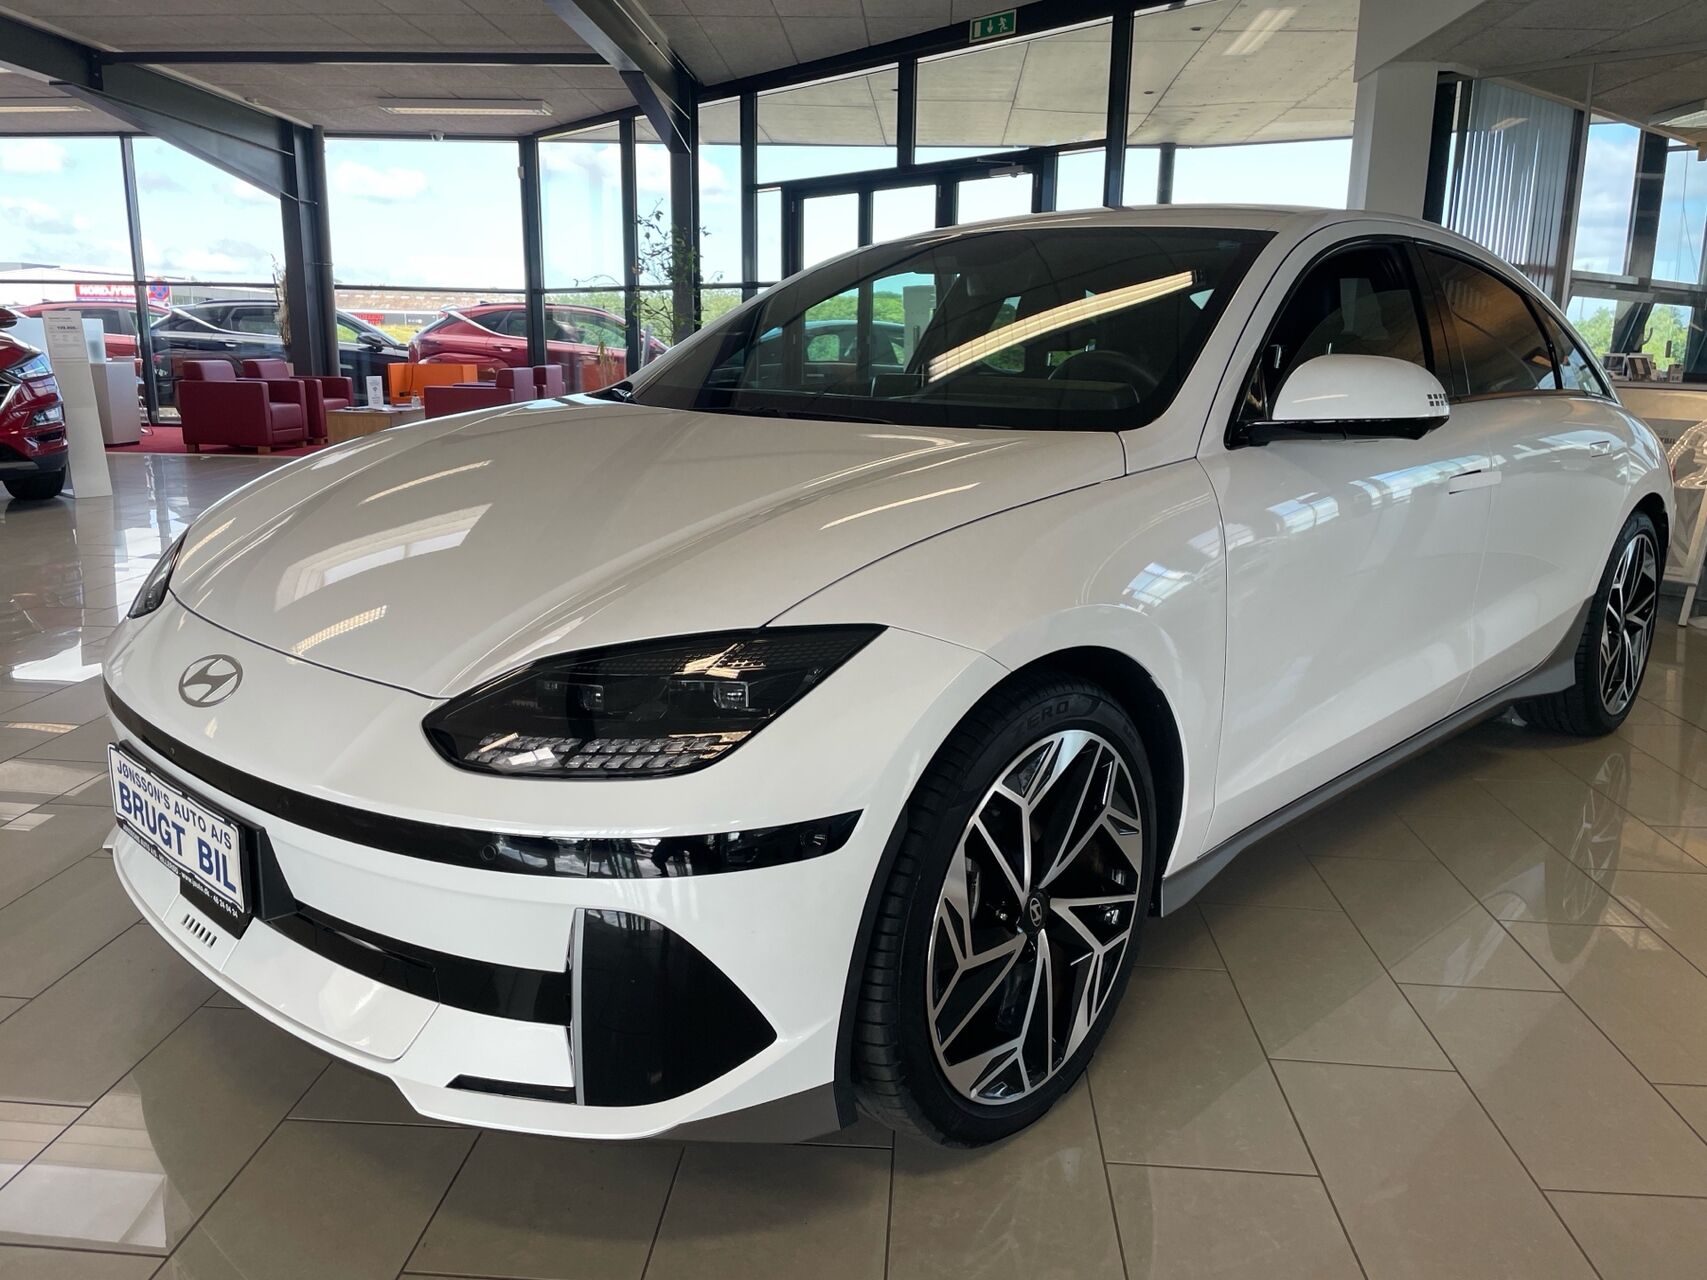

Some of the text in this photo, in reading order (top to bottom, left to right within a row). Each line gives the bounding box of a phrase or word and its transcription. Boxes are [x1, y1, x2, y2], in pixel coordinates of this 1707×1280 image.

[117, 760, 232, 850] JØNSSON'S AUTO A/S
[118, 780, 236, 894] BRUGT BIL
